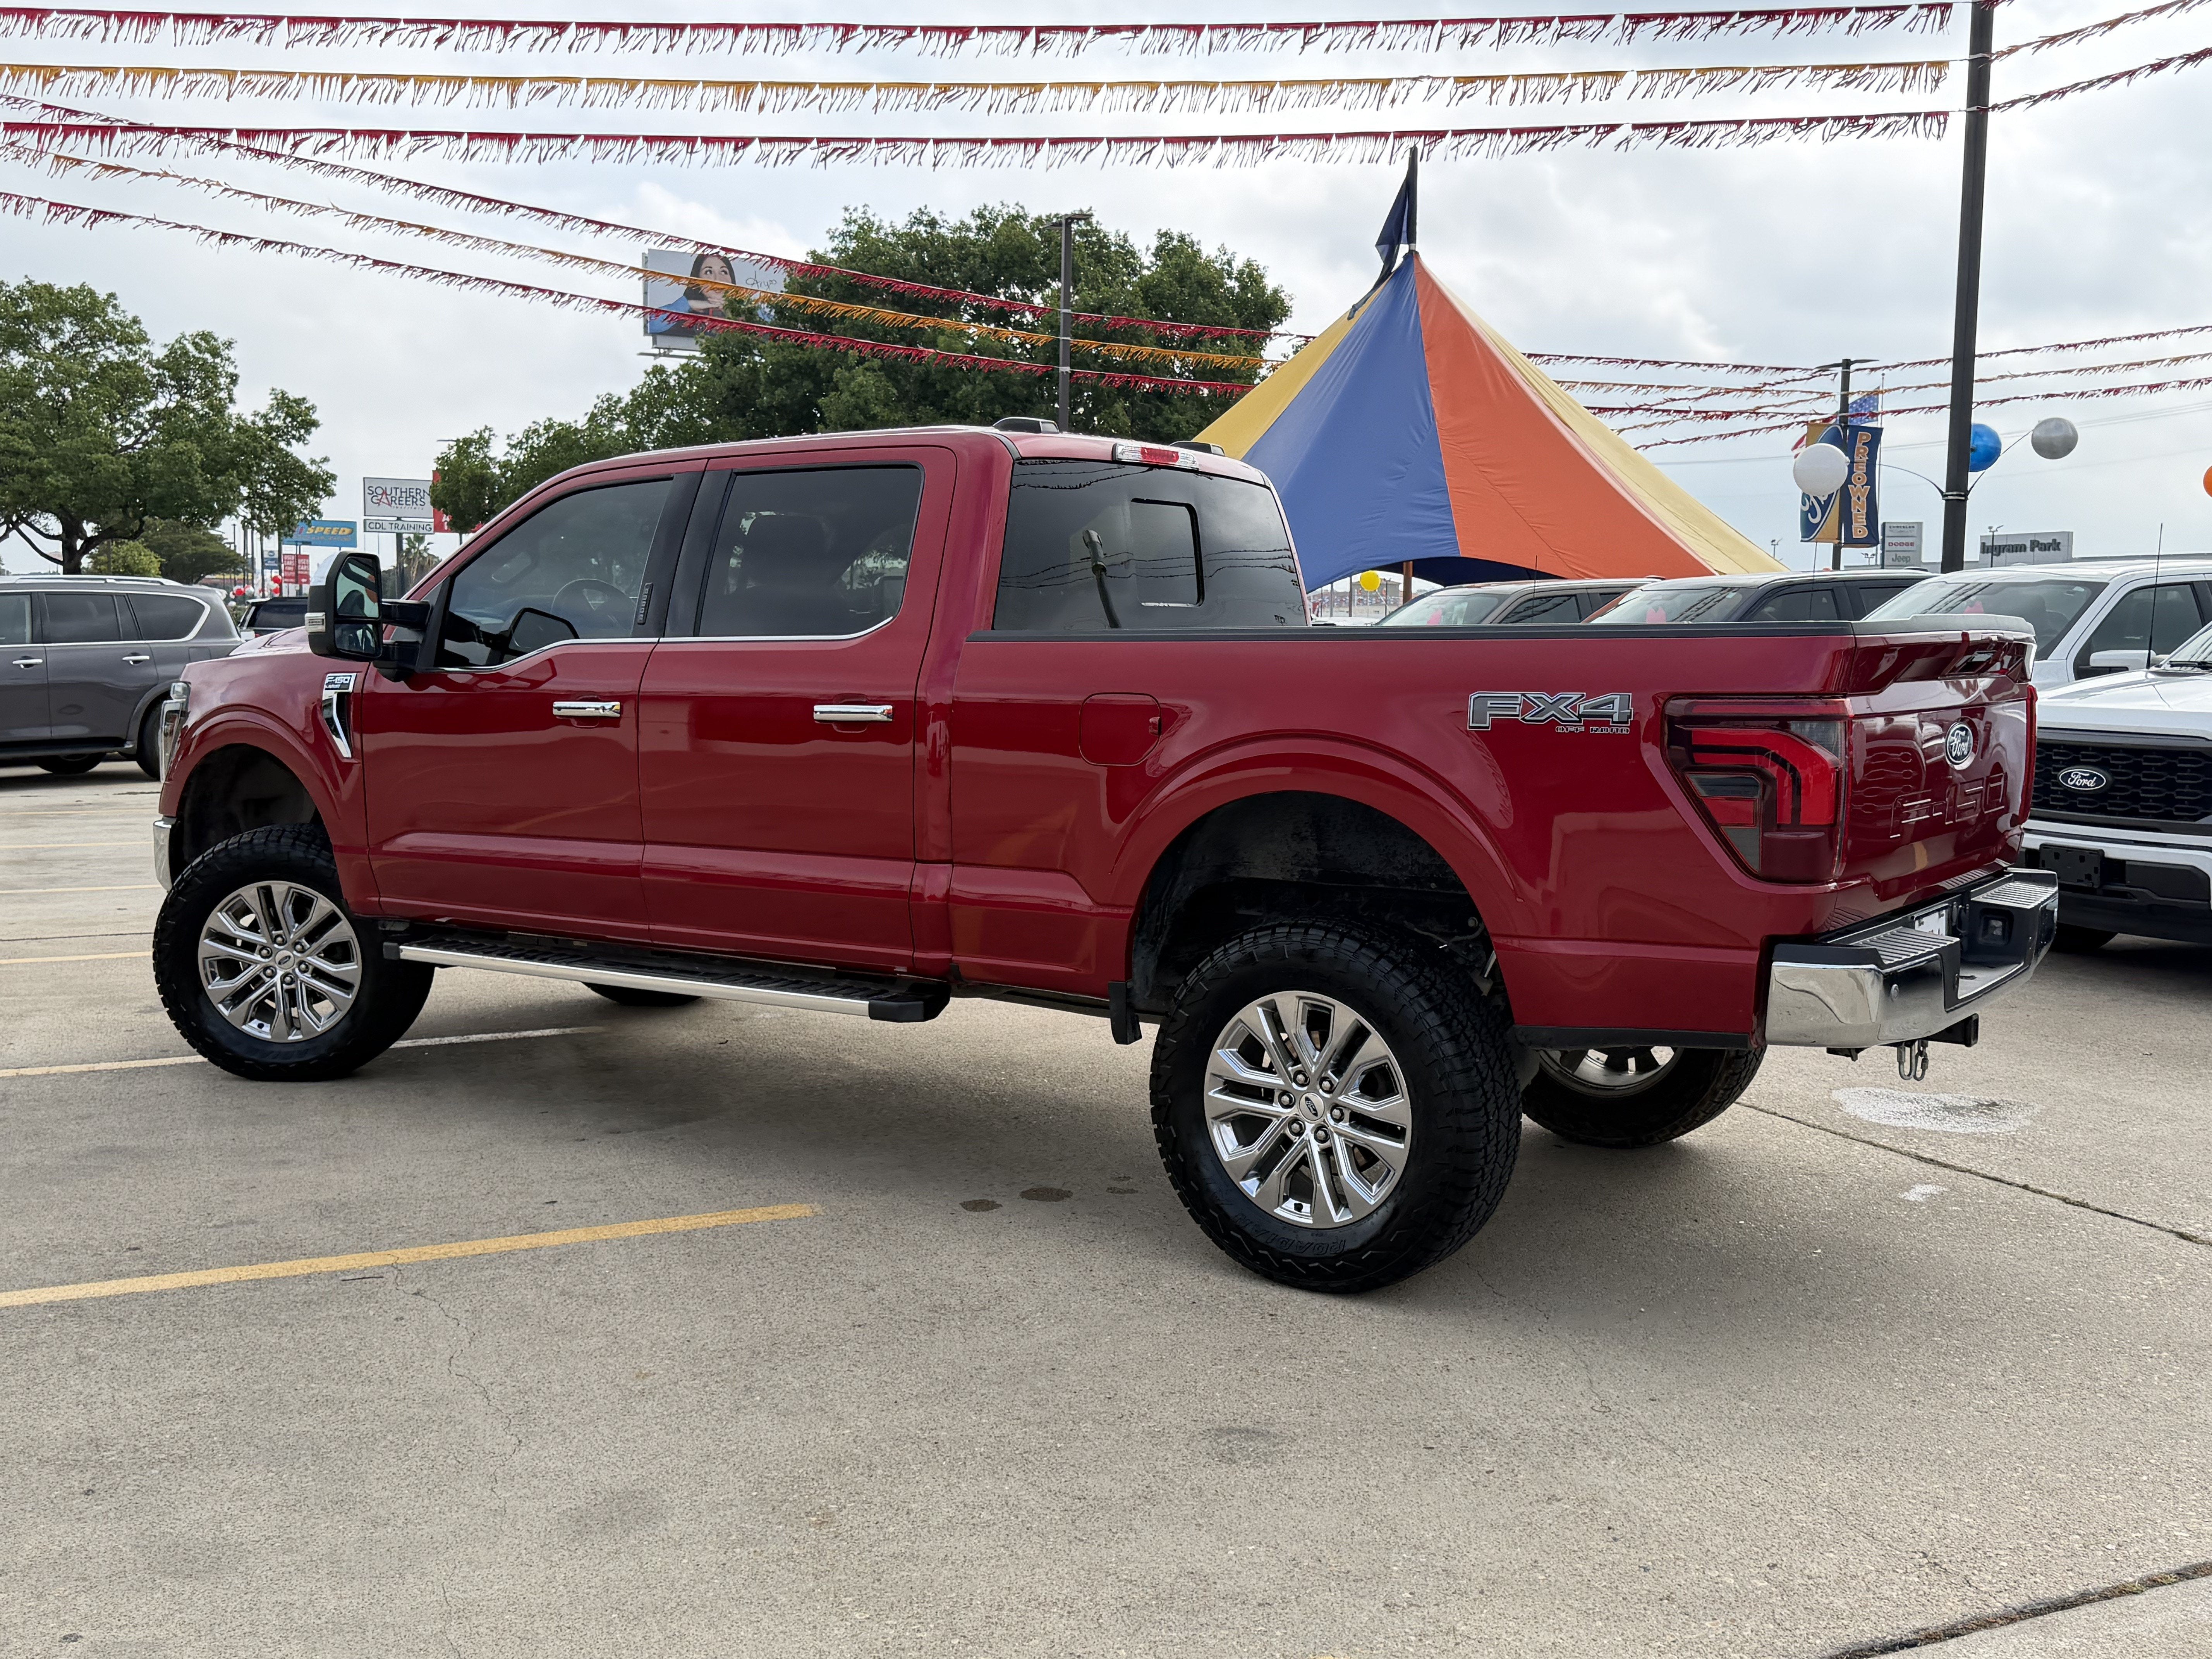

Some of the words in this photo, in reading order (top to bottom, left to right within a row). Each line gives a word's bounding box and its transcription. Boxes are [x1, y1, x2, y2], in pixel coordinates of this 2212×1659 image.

[368, 486, 431, 499] SOUTHERN
[1848, 431, 1872, 539] PREOWNED
[371, 490, 426, 507] CAREERS
[306, 526, 354, 535] SPEED
[368, 522, 386, 530] CDL
[390, 522, 432, 532] TRAINING
[1980, 542, 2027, 556] Ingram
[2030, 538, 2061, 552] Park
[1892, 553, 1911, 563] Jeep
[1467, 691, 1633, 730] FX4
[1950, 730, 1970, 757] Ford
[2068, 771, 2097, 787] Ford
[1890, 772, 2008, 838] F-150
